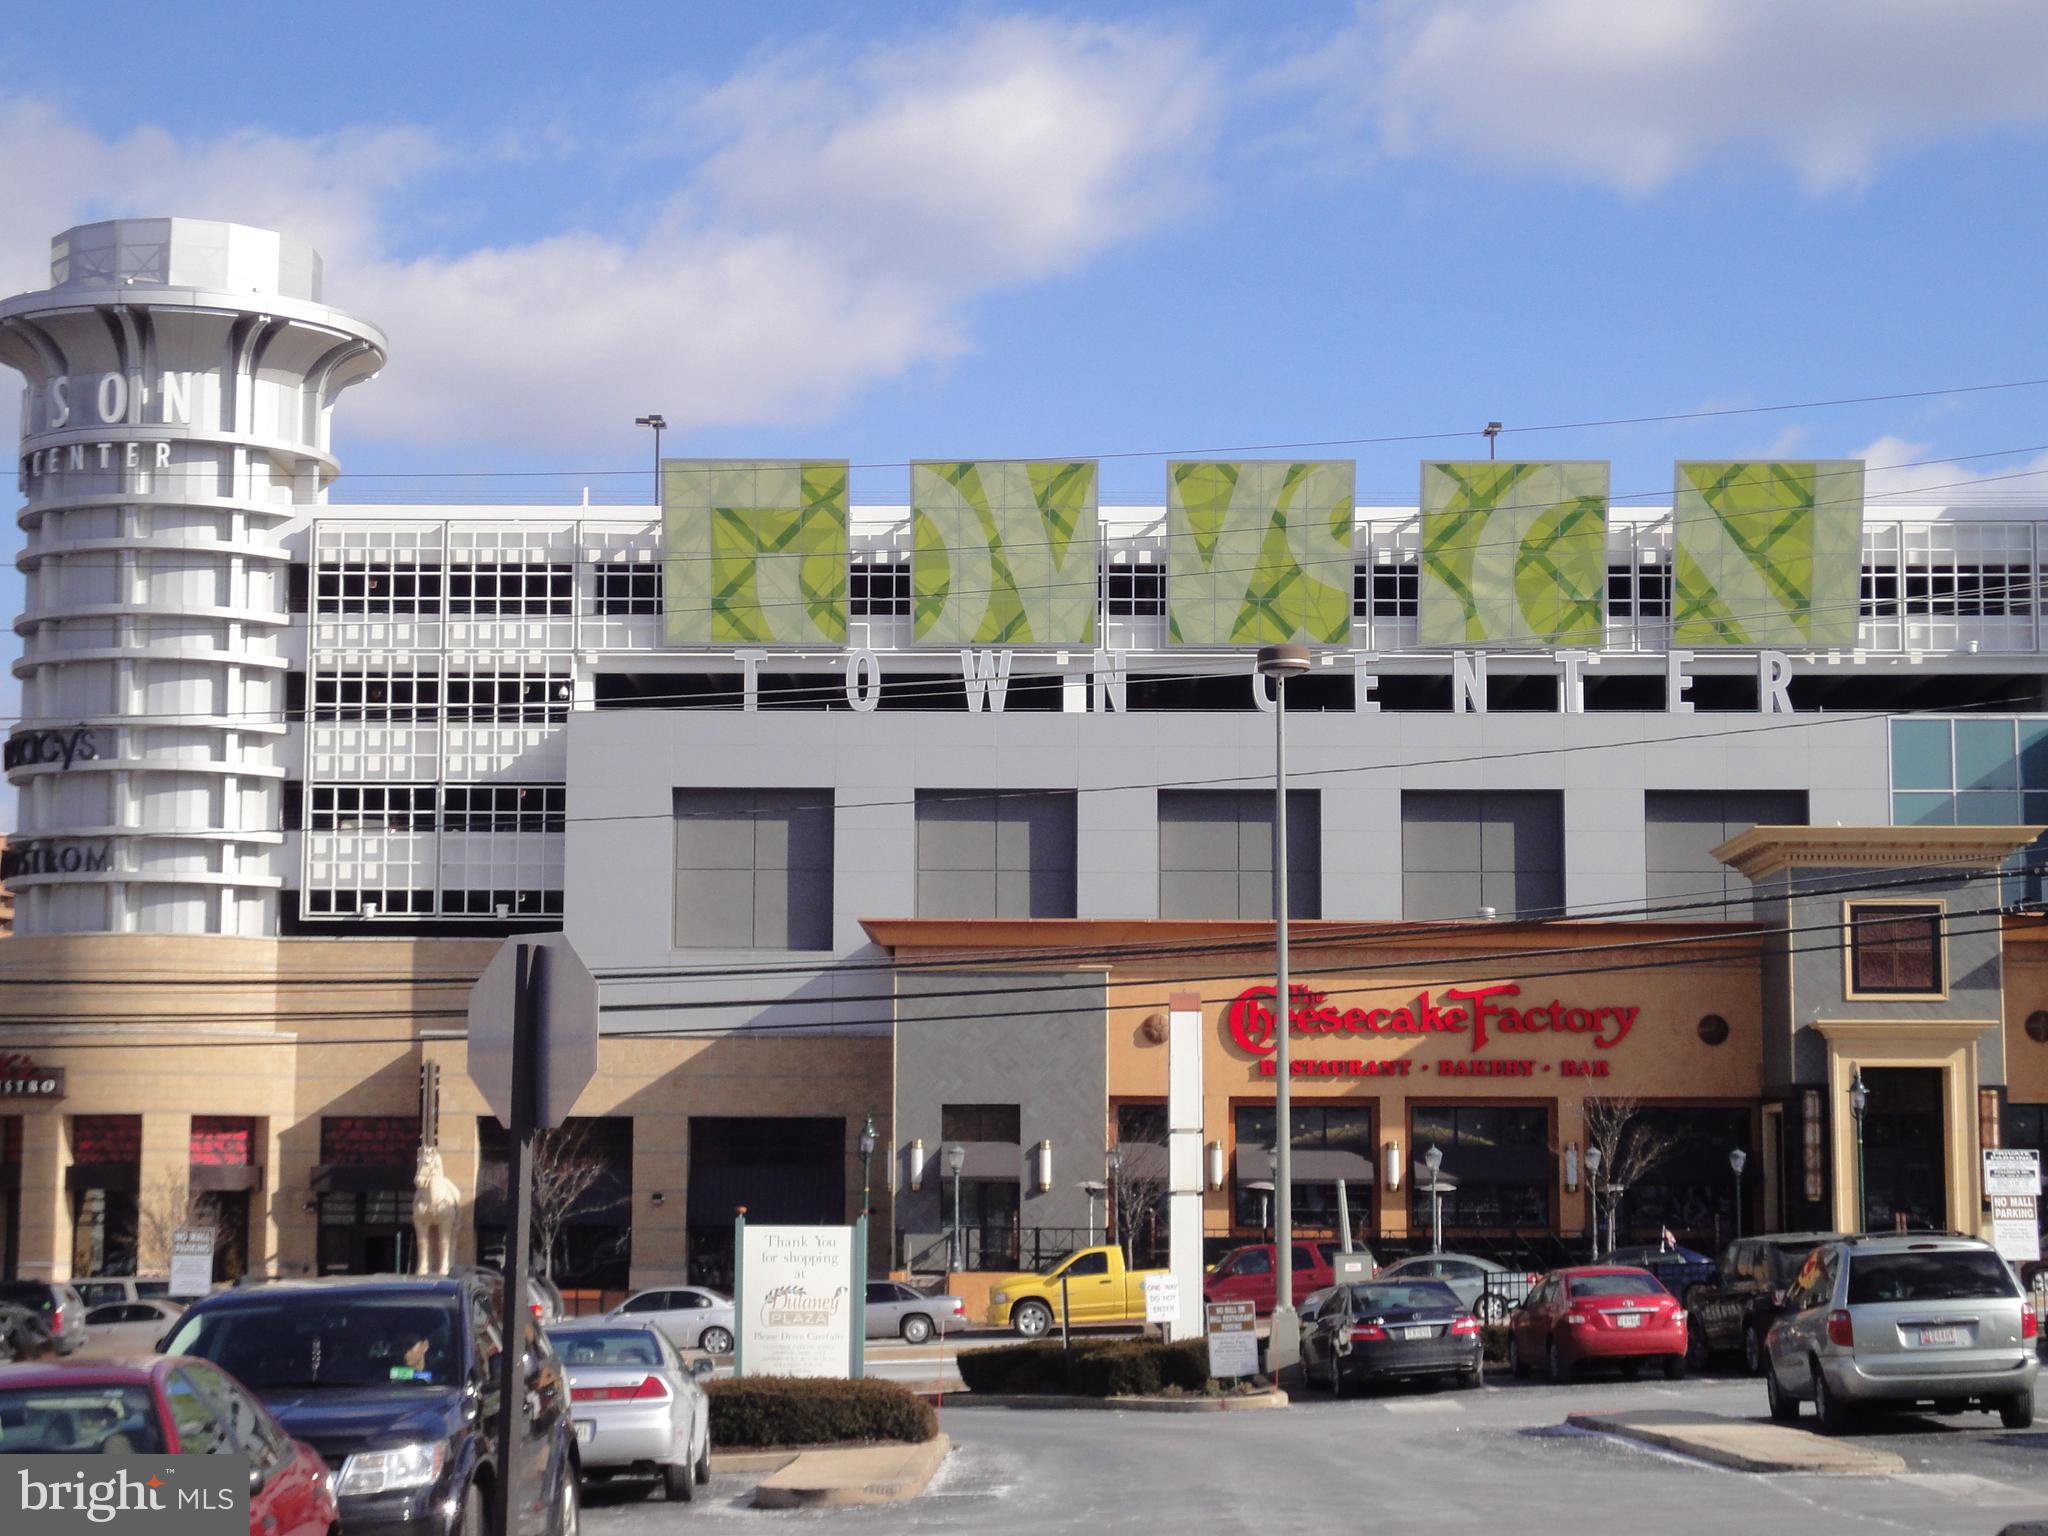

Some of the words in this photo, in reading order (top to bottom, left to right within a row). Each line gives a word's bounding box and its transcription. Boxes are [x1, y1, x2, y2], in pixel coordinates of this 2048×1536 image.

[32, 443, 171, 477] CENTER
[734, 649, 1126, 712] TOWN
[1252, 650, 1794, 713] CENTER
[1229, 986, 1467, 1055] Cheesecake
[1448, 984, 1640, 1052] Factory
[1259, 1059, 1412, 1076] RSTAURANT
[1439, 1059, 1537, 1076] BAKERY
[1561, 1059, 1610, 1077] BAR
[1994, 1196, 2007, 1208] NO
[2010, 1196, 2034, 1208] MALL
[1995, 1207, 2034, 1218] PARKING
[764, 1234, 808, 1248] Thank
[815, 1234, 837, 1248] You
[762, 1251, 778, 1263] for
[784, 1251, 839, 1267] shopping
[794, 1269, 805, 1279] at
[1153, 1305, 1175, 1313] ENTER
[771, 1312, 828, 1324] PLAZA
